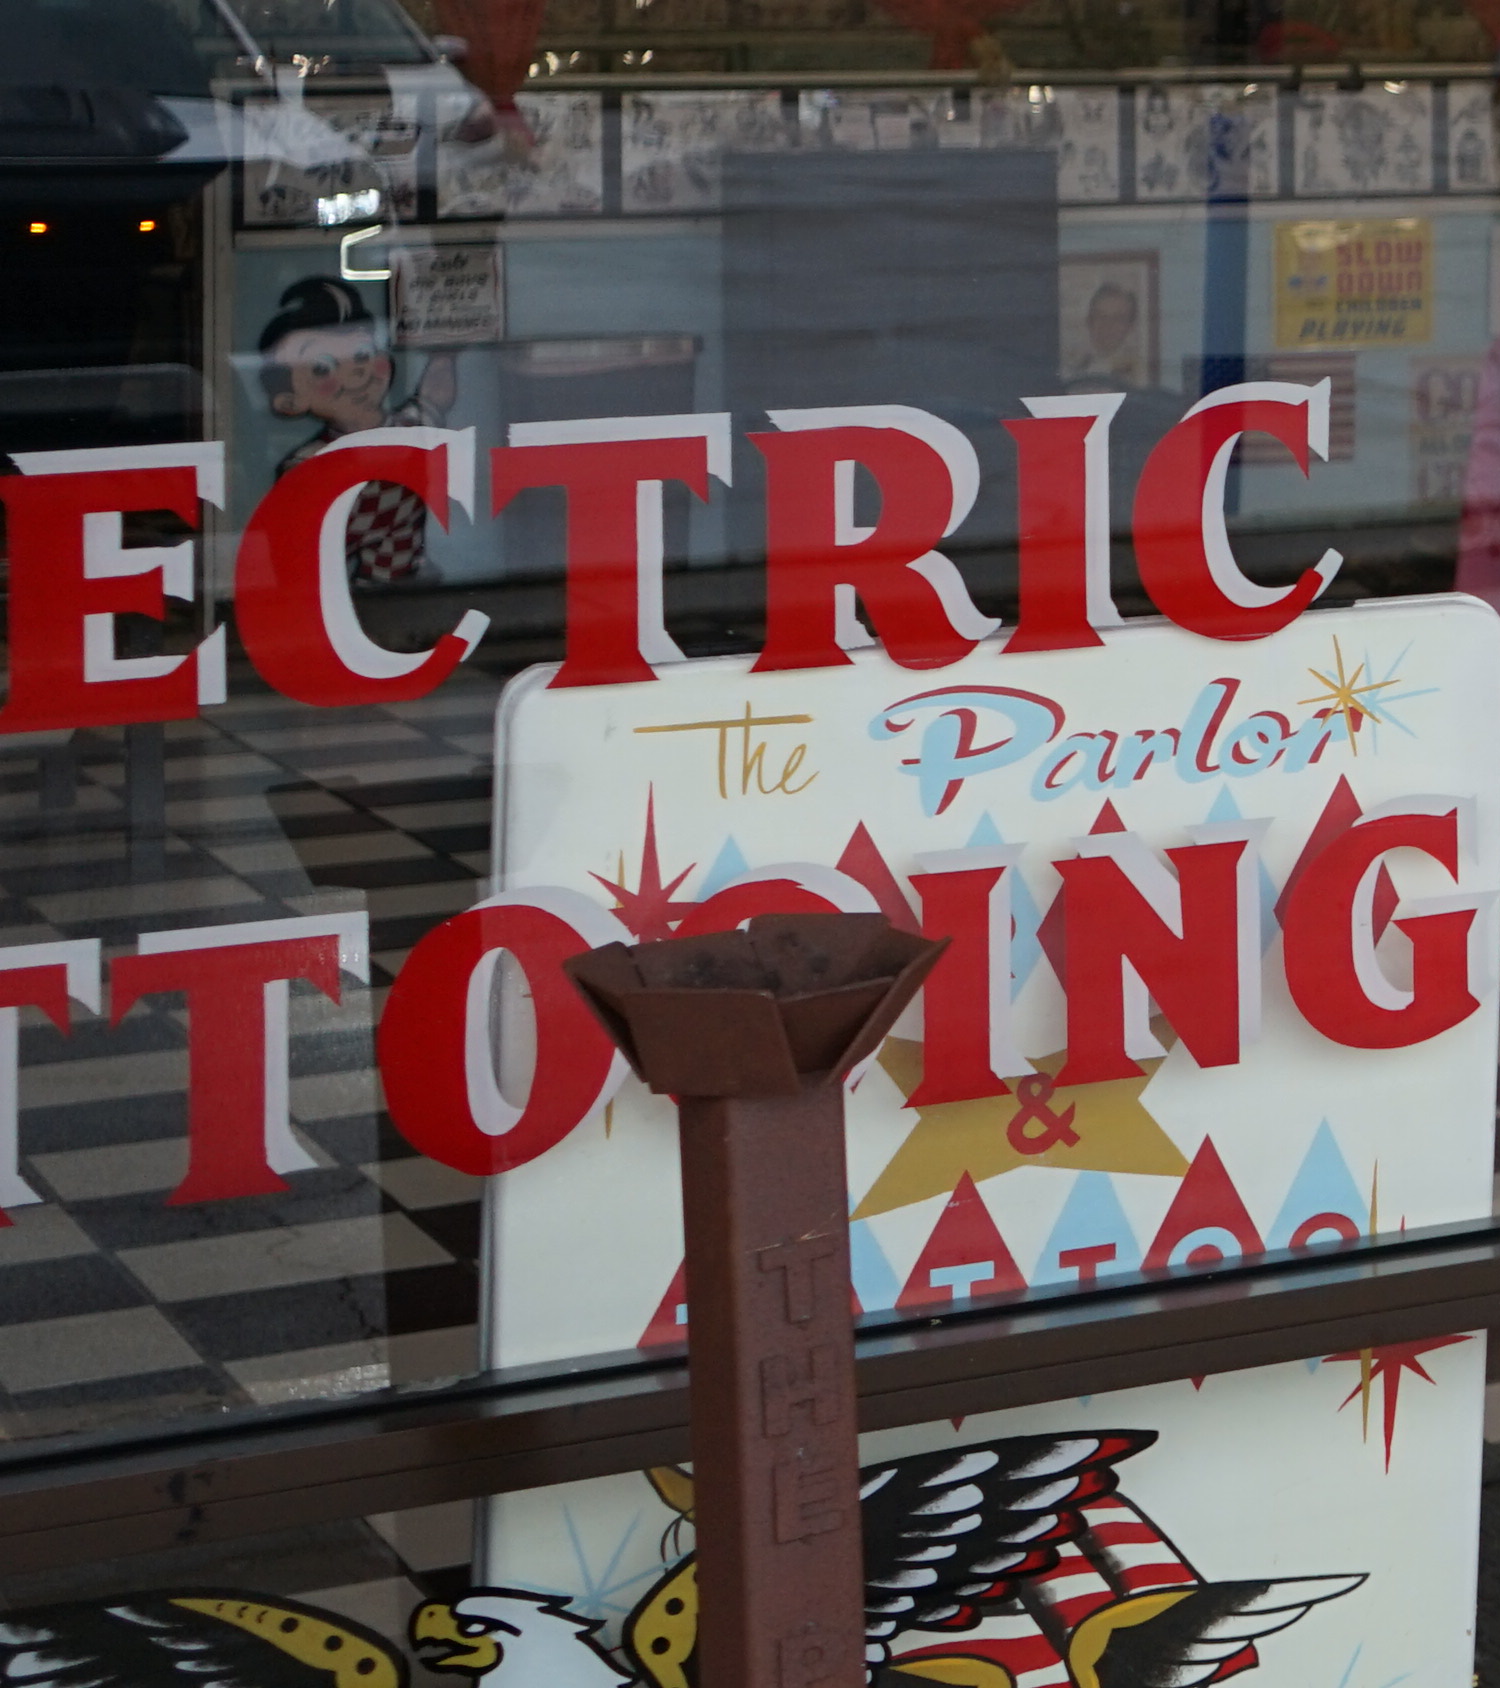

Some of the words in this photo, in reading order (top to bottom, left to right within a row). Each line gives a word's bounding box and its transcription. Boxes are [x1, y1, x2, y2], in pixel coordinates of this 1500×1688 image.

[1336, 238, 1423, 268] SLOW
[1336, 269, 1423, 297] DOWN
[1300, 316, 1407, 341] PLAYING
[633, 700, 819, 799] The
[868, 677, 1365, 817] Parlor
[1005, 1072, 1080, 1155] &
[757, 1240, 842, 1546] THE
